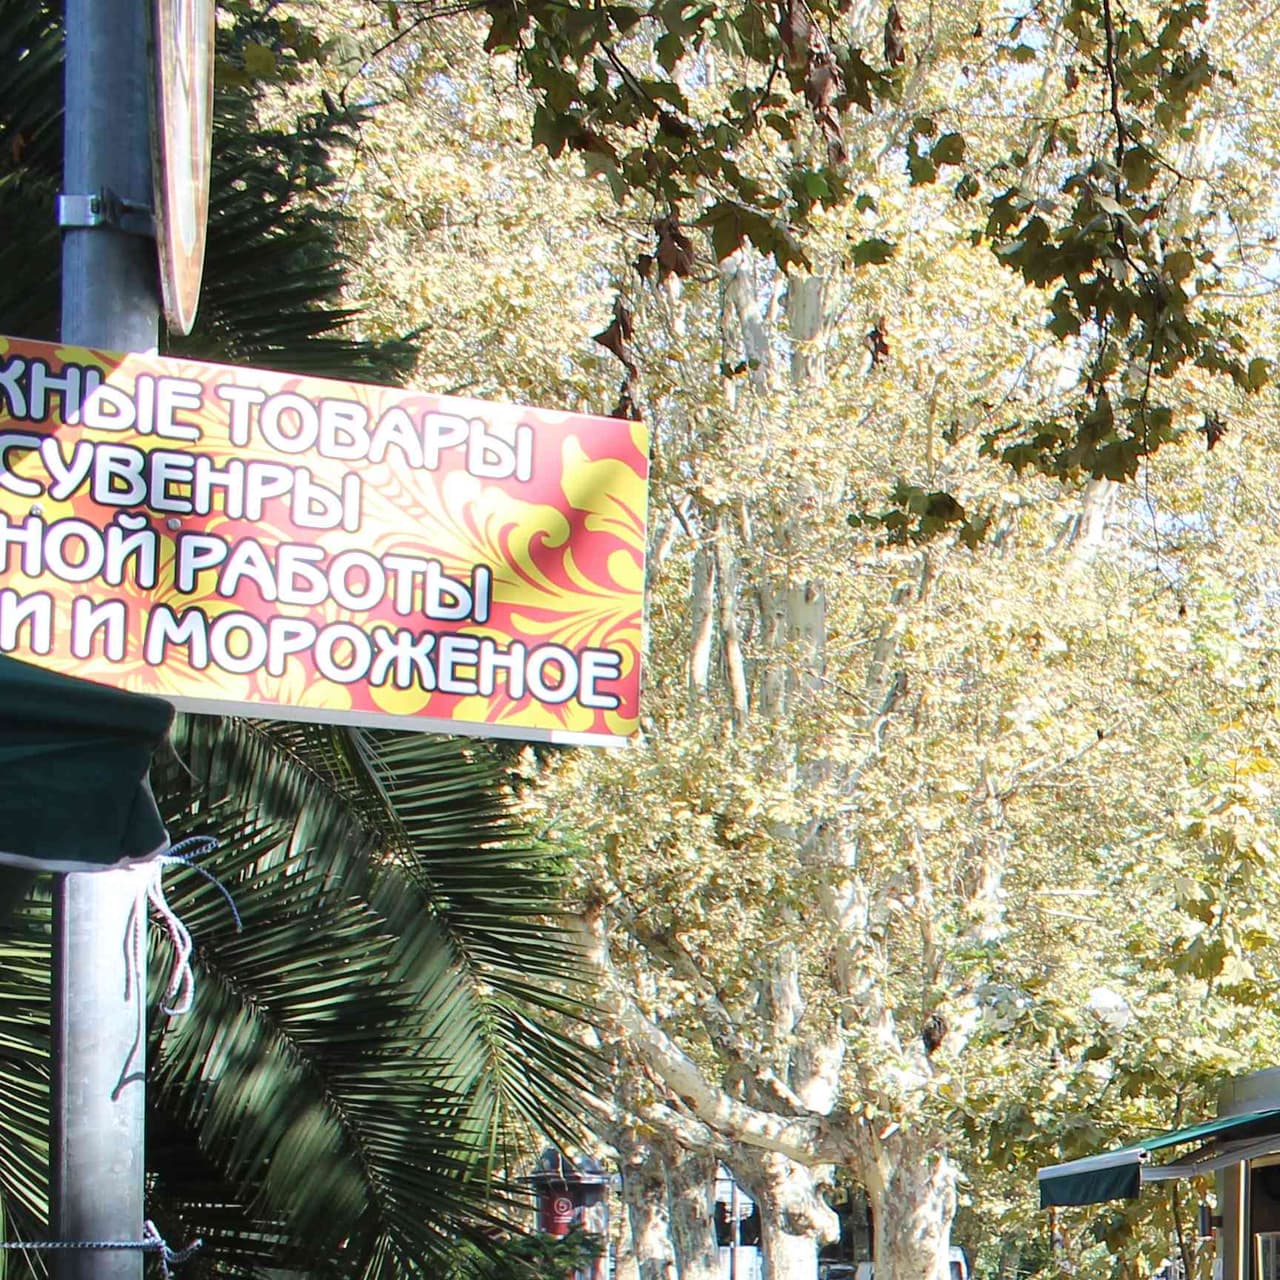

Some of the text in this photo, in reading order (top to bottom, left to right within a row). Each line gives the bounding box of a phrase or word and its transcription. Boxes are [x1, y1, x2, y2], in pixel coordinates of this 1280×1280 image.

[0, 432, 362, 532] СУВЕНРЫ
[216, 386, 533, 482] ТОВАРЫ
[176, 532, 490, 623] РАБОТЫ
[72, 594, 127, 660] И
[143, 606, 621, 709] МОРОЖЕНОЕ
